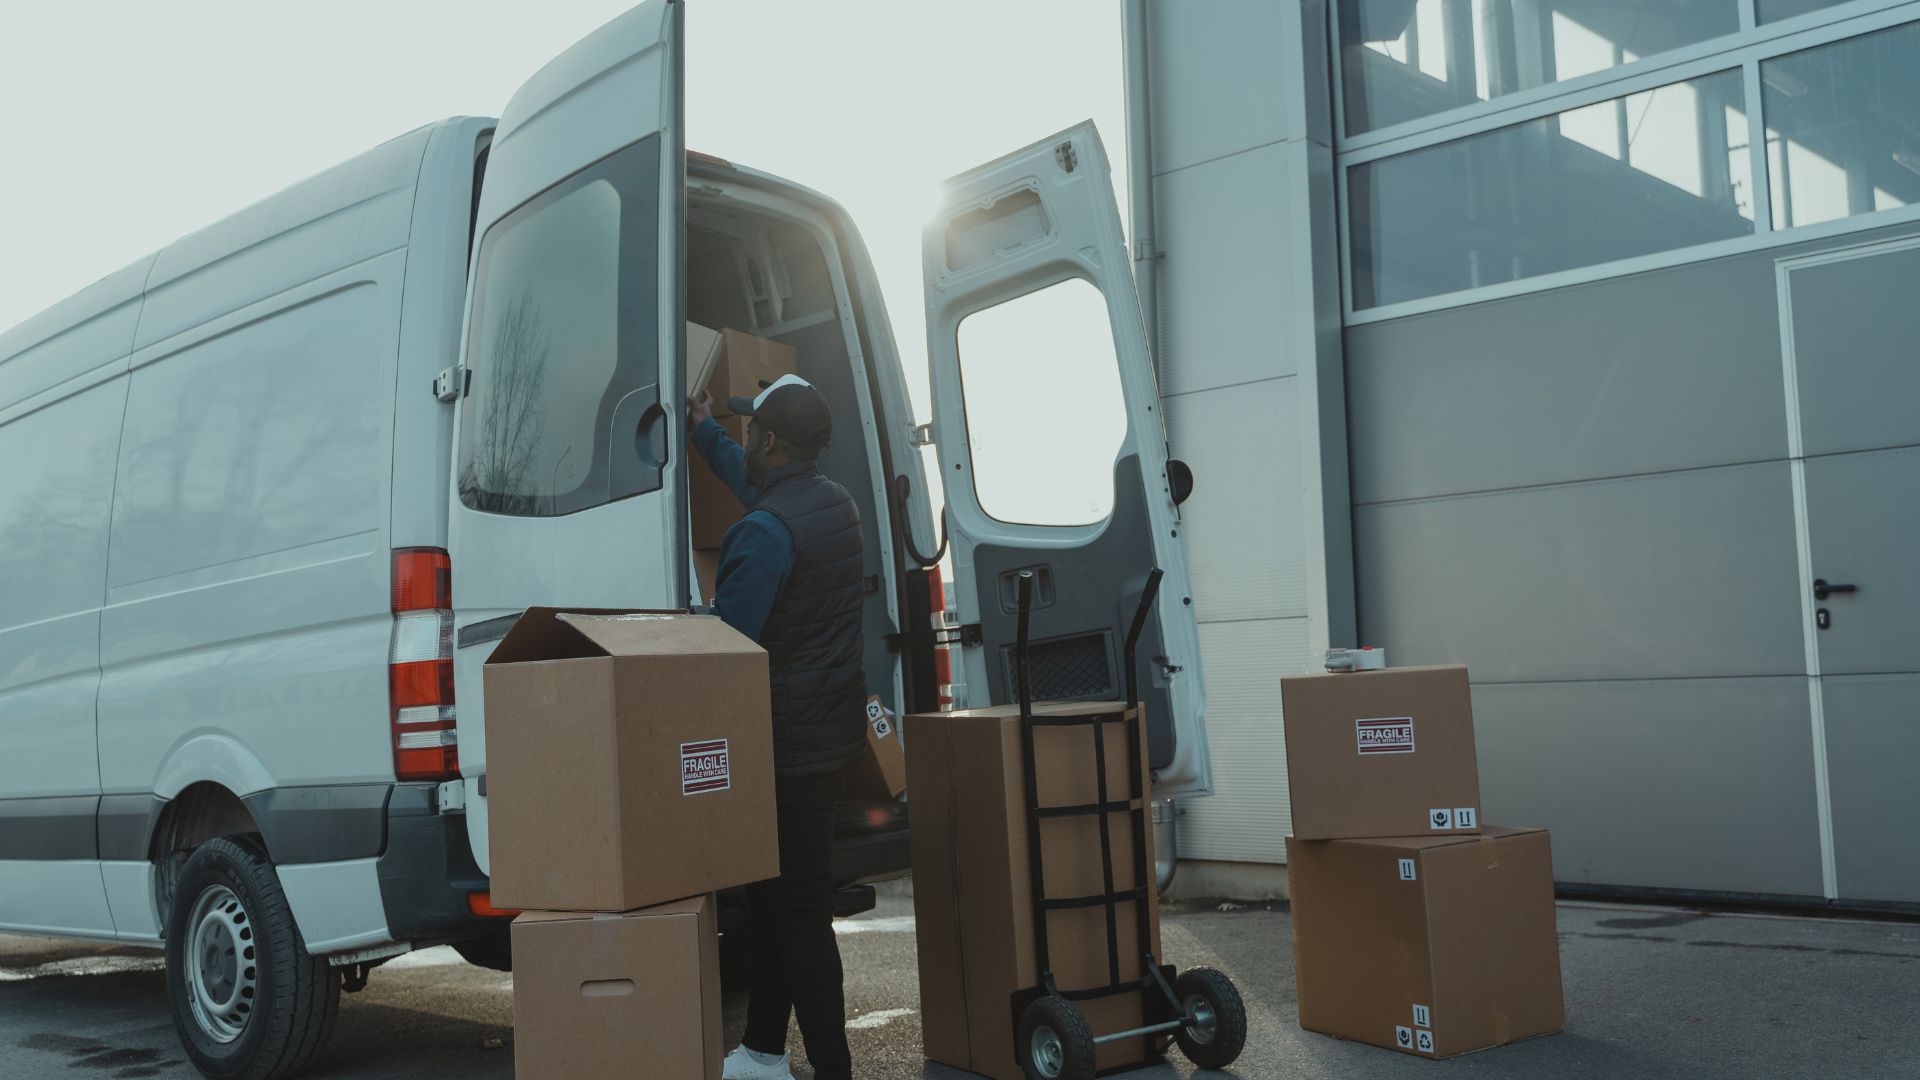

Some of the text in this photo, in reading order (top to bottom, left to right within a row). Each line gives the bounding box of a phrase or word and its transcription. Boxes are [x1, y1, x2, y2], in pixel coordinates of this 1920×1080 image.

[1359, 728, 1410, 739] FRAGILE
[684, 755, 726, 773] FRAGILE
[685, 771, 703, 780] HANDLE
[703, 769, 714, 777] WITH
